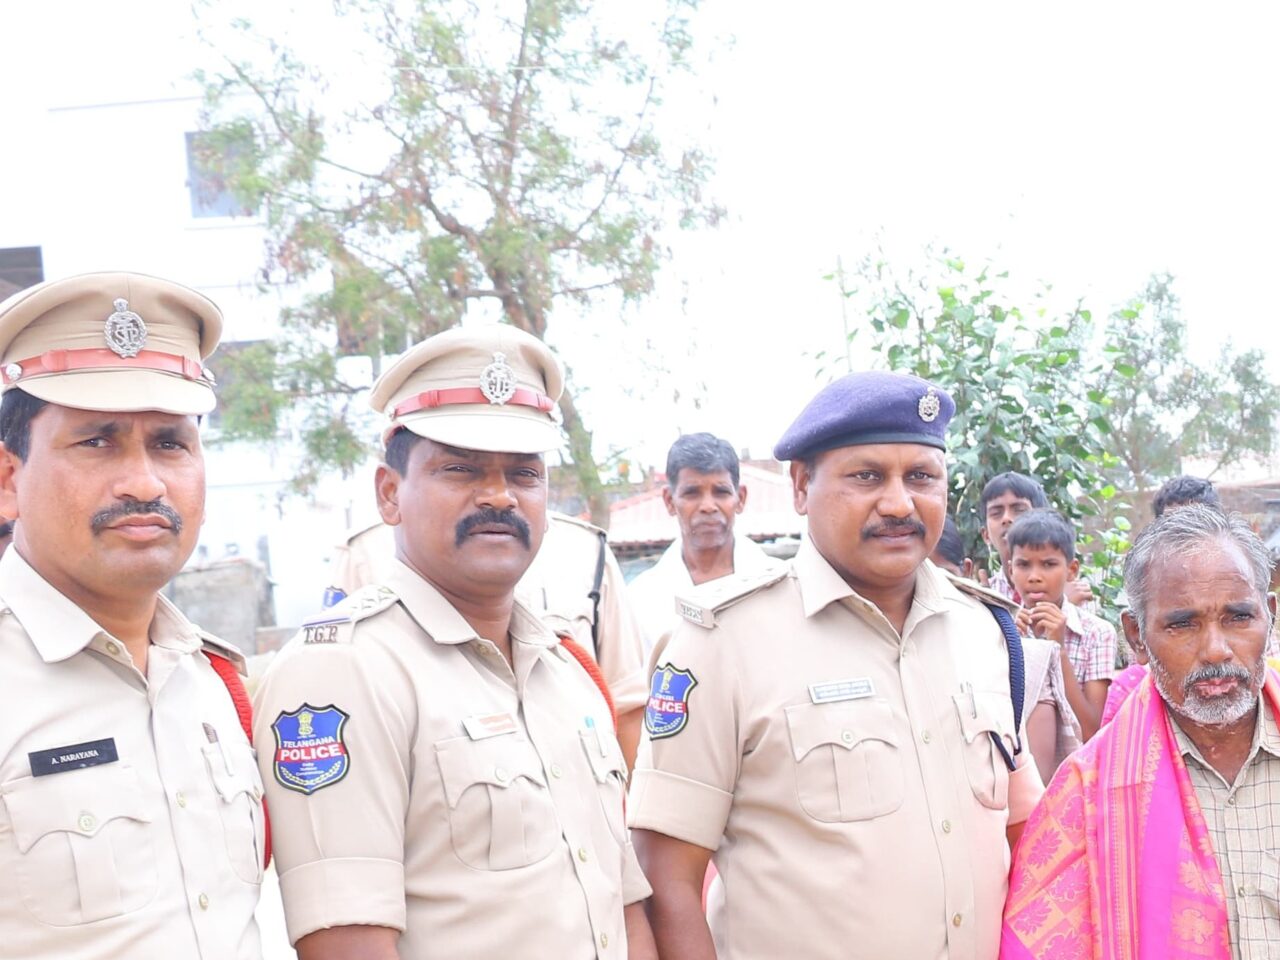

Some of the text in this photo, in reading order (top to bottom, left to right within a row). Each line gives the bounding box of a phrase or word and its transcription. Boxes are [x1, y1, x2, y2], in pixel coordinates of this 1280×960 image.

[283, 736, 335, 748] TELANGANA
[51, 749, 99, 765] A. NARAYANA
[280, 744, 341, 761] POLICE
